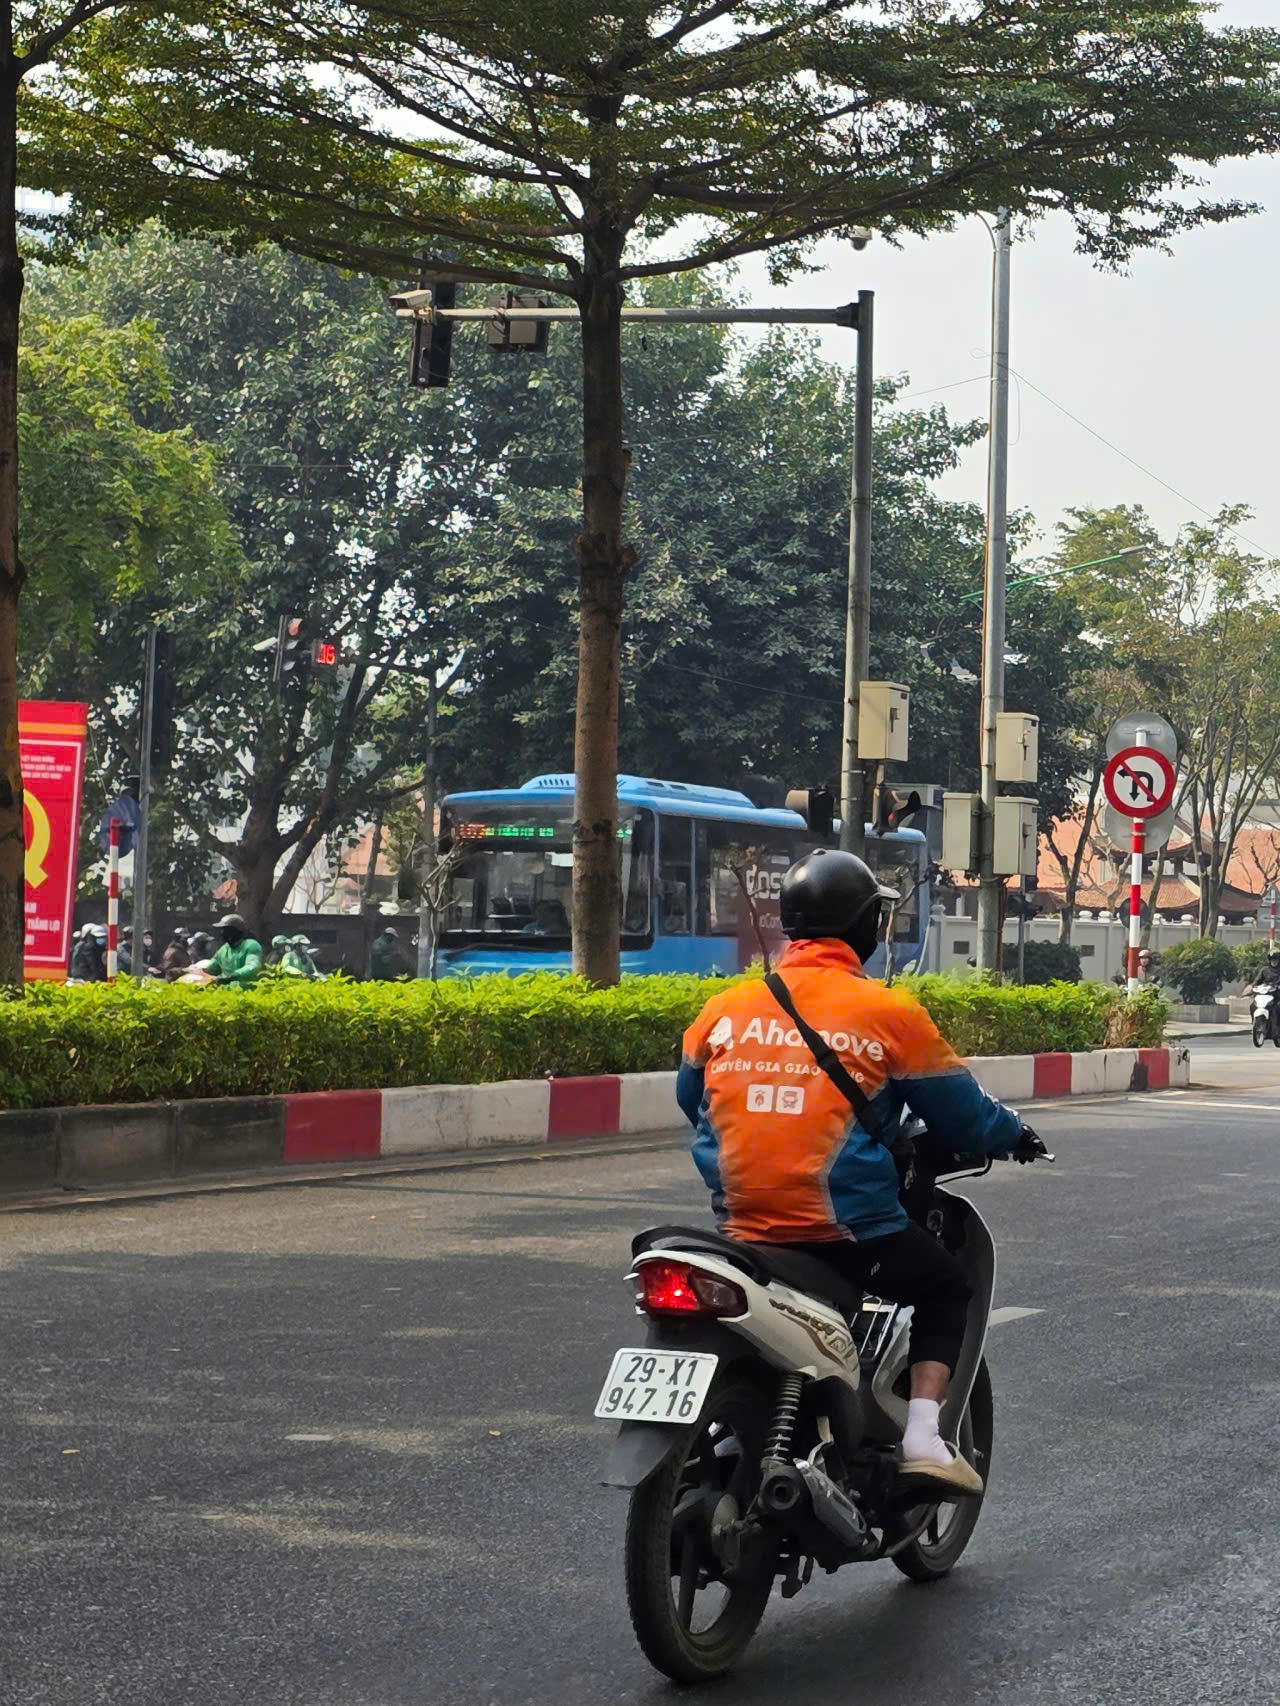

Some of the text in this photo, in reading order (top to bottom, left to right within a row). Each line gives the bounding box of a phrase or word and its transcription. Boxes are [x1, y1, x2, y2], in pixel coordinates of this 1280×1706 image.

[755, 1061, 780, 1073] GIA
[624, 1356, 699, 1387] 29-X1
[604, 1387, 697, 1417] 947.16
